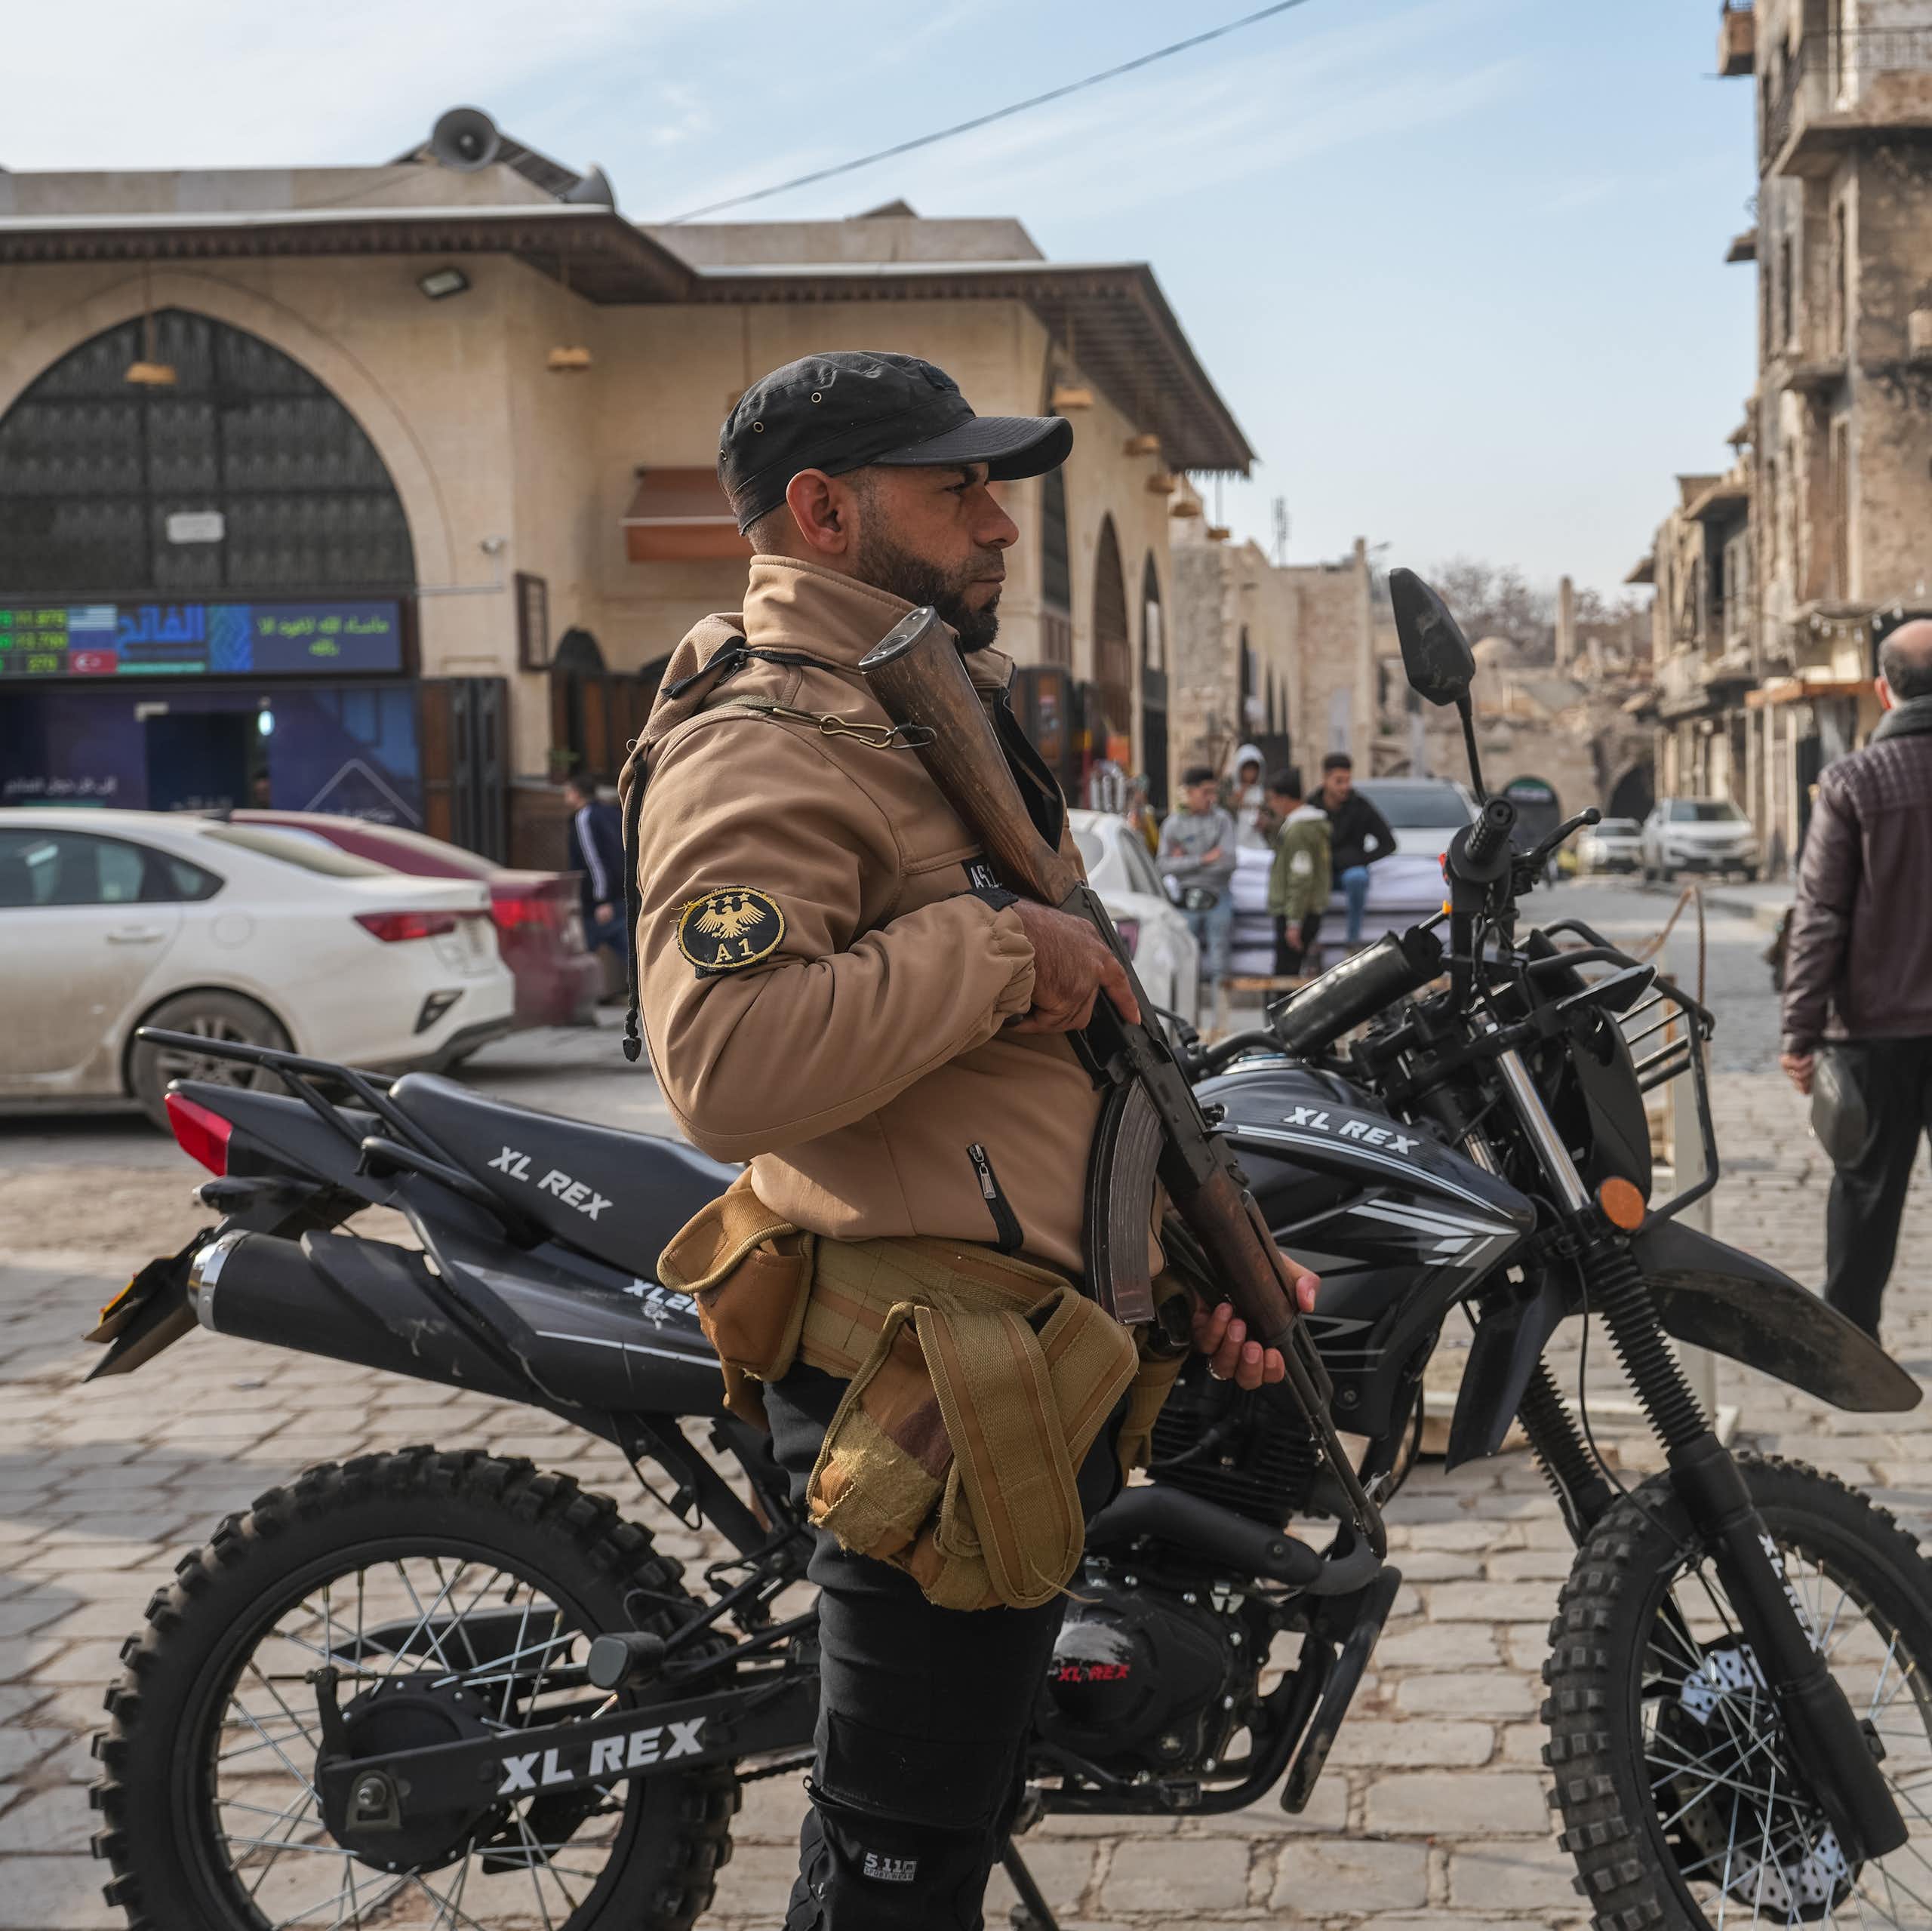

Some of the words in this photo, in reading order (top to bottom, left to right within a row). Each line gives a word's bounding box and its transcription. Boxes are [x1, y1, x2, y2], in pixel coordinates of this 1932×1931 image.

[1283, 1106, 1331, 1131] XL
[1338, 1119, 1420, 1155] REX
[488, 1145, 531, 1182] XL
[537, 1169, 613, 1221] REX
[623, 1278, 699, 1317] XL2
[1057, 1665, 1081, 1682] XL
[1088, 1664, 1131, 1680] REX
[497, 1747, 574, 1795] XL
[589, 1716, 707, 1776] REX
